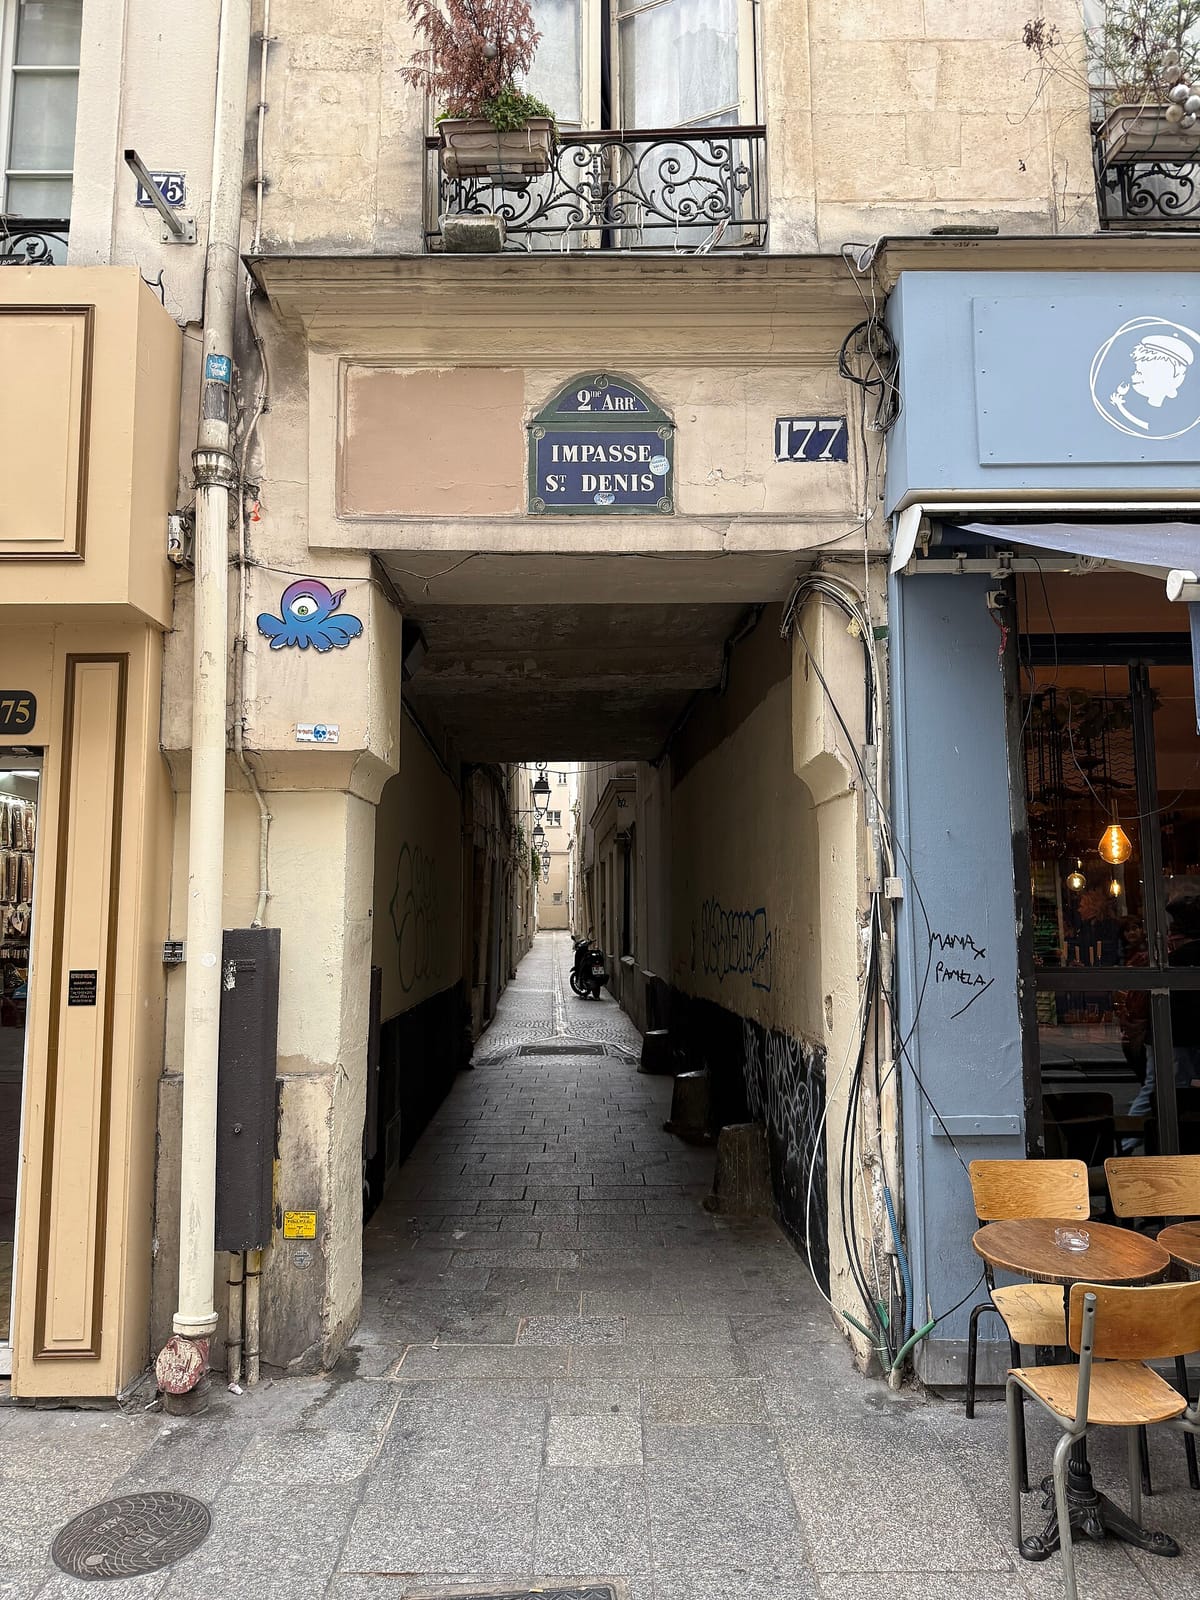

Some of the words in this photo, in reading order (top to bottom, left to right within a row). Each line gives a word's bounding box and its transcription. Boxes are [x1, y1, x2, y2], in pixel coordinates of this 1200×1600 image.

[778, 421, 843, 459] 177
[551, 445, 651, 463] IMPASSE
[581, 474, 655, 492] DENIS
